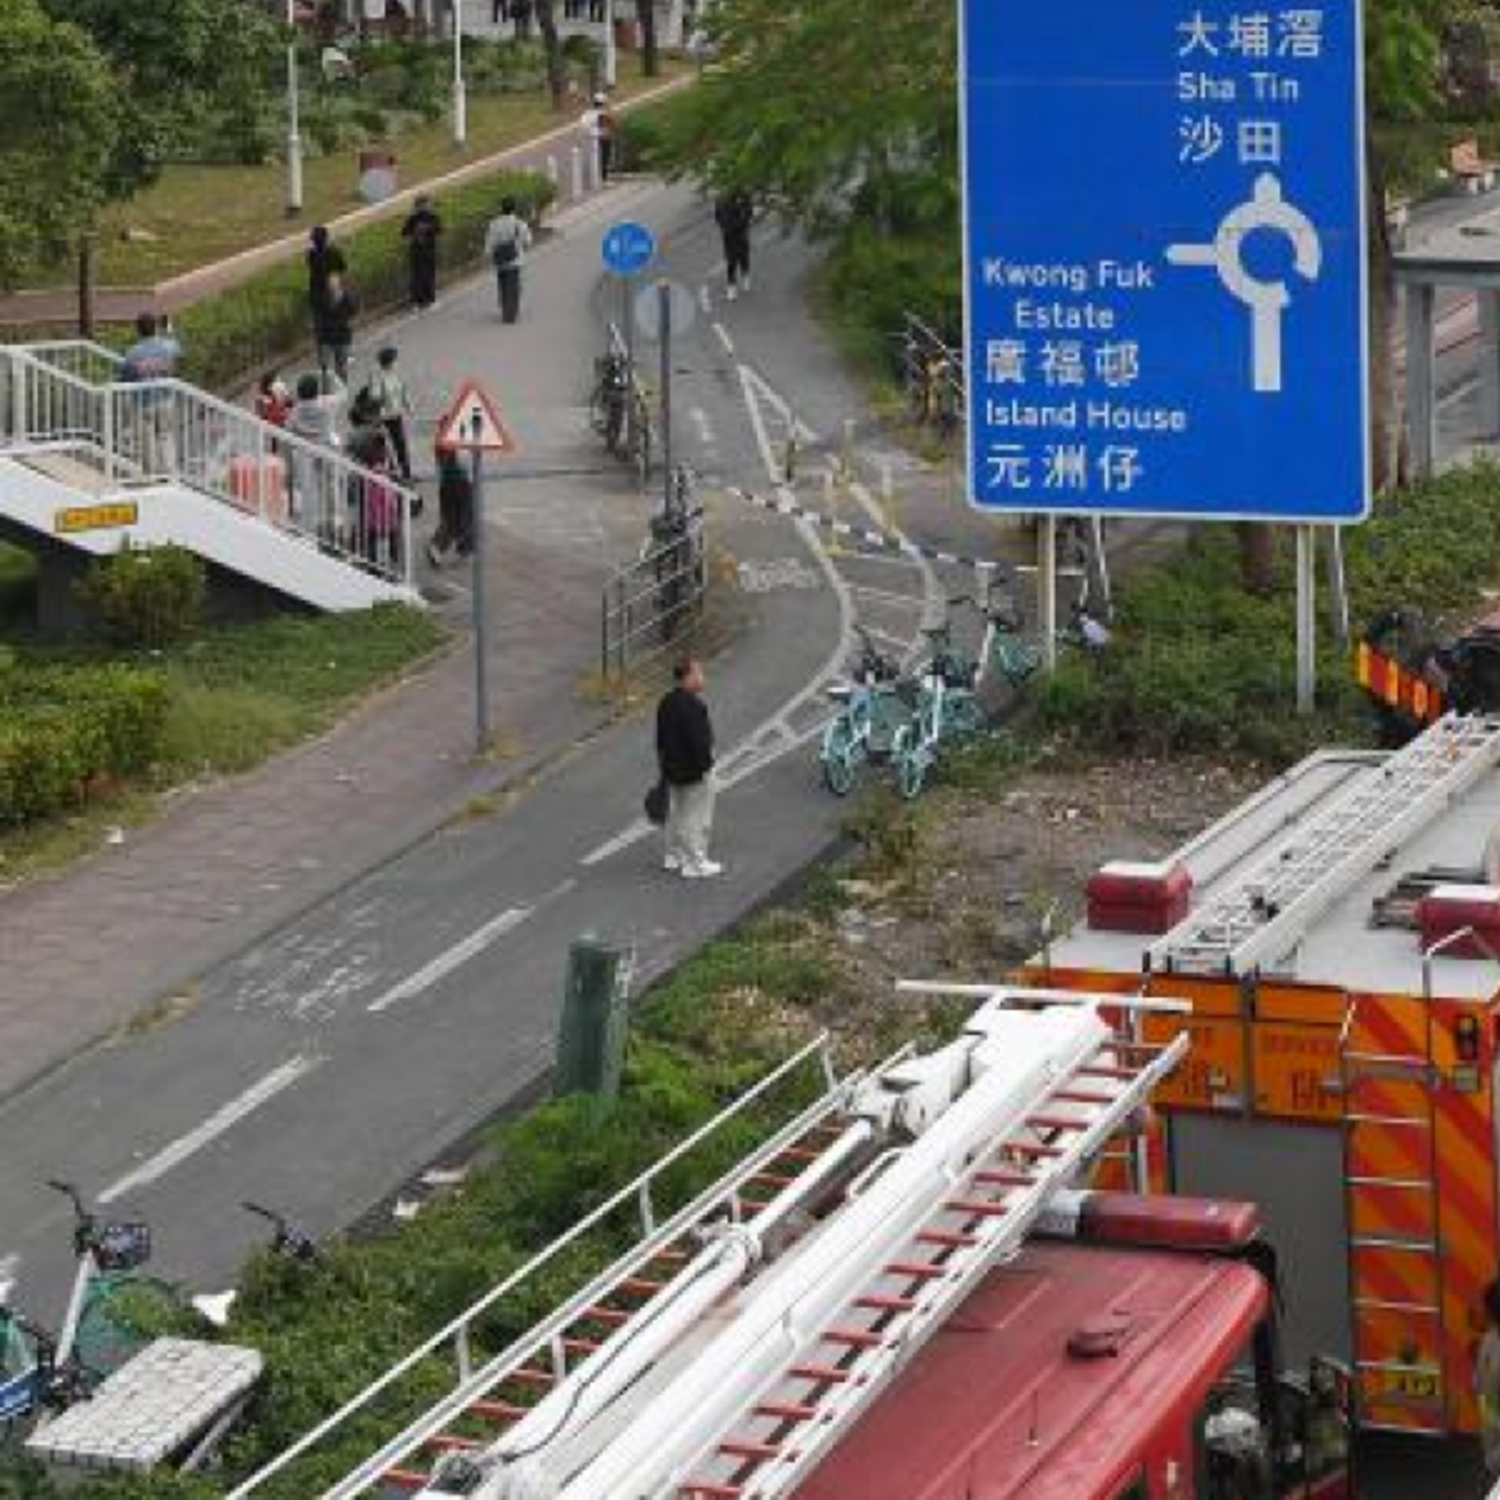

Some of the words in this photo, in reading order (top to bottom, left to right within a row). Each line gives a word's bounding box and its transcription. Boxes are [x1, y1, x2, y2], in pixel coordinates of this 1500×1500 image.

[1175, 9, 1324, 58] 大埔滘
[1178, 71, 1236, 100] Sha
[1250, 71, 1299, 101] Tin
[1178, 114, 1281, 164] 沙田
[983, 258, 1088, 291] Kwong
[1099, 260, 1153, 288] Fuk
[1016, 301, 1114, 329] Estate
[986, 339, 1140, 387] 廣福邨
[986, 400, 1076, 426] Island
[1087, 401, 1186, 432] House
[986, 443, 1143, 491] 元洲仔
